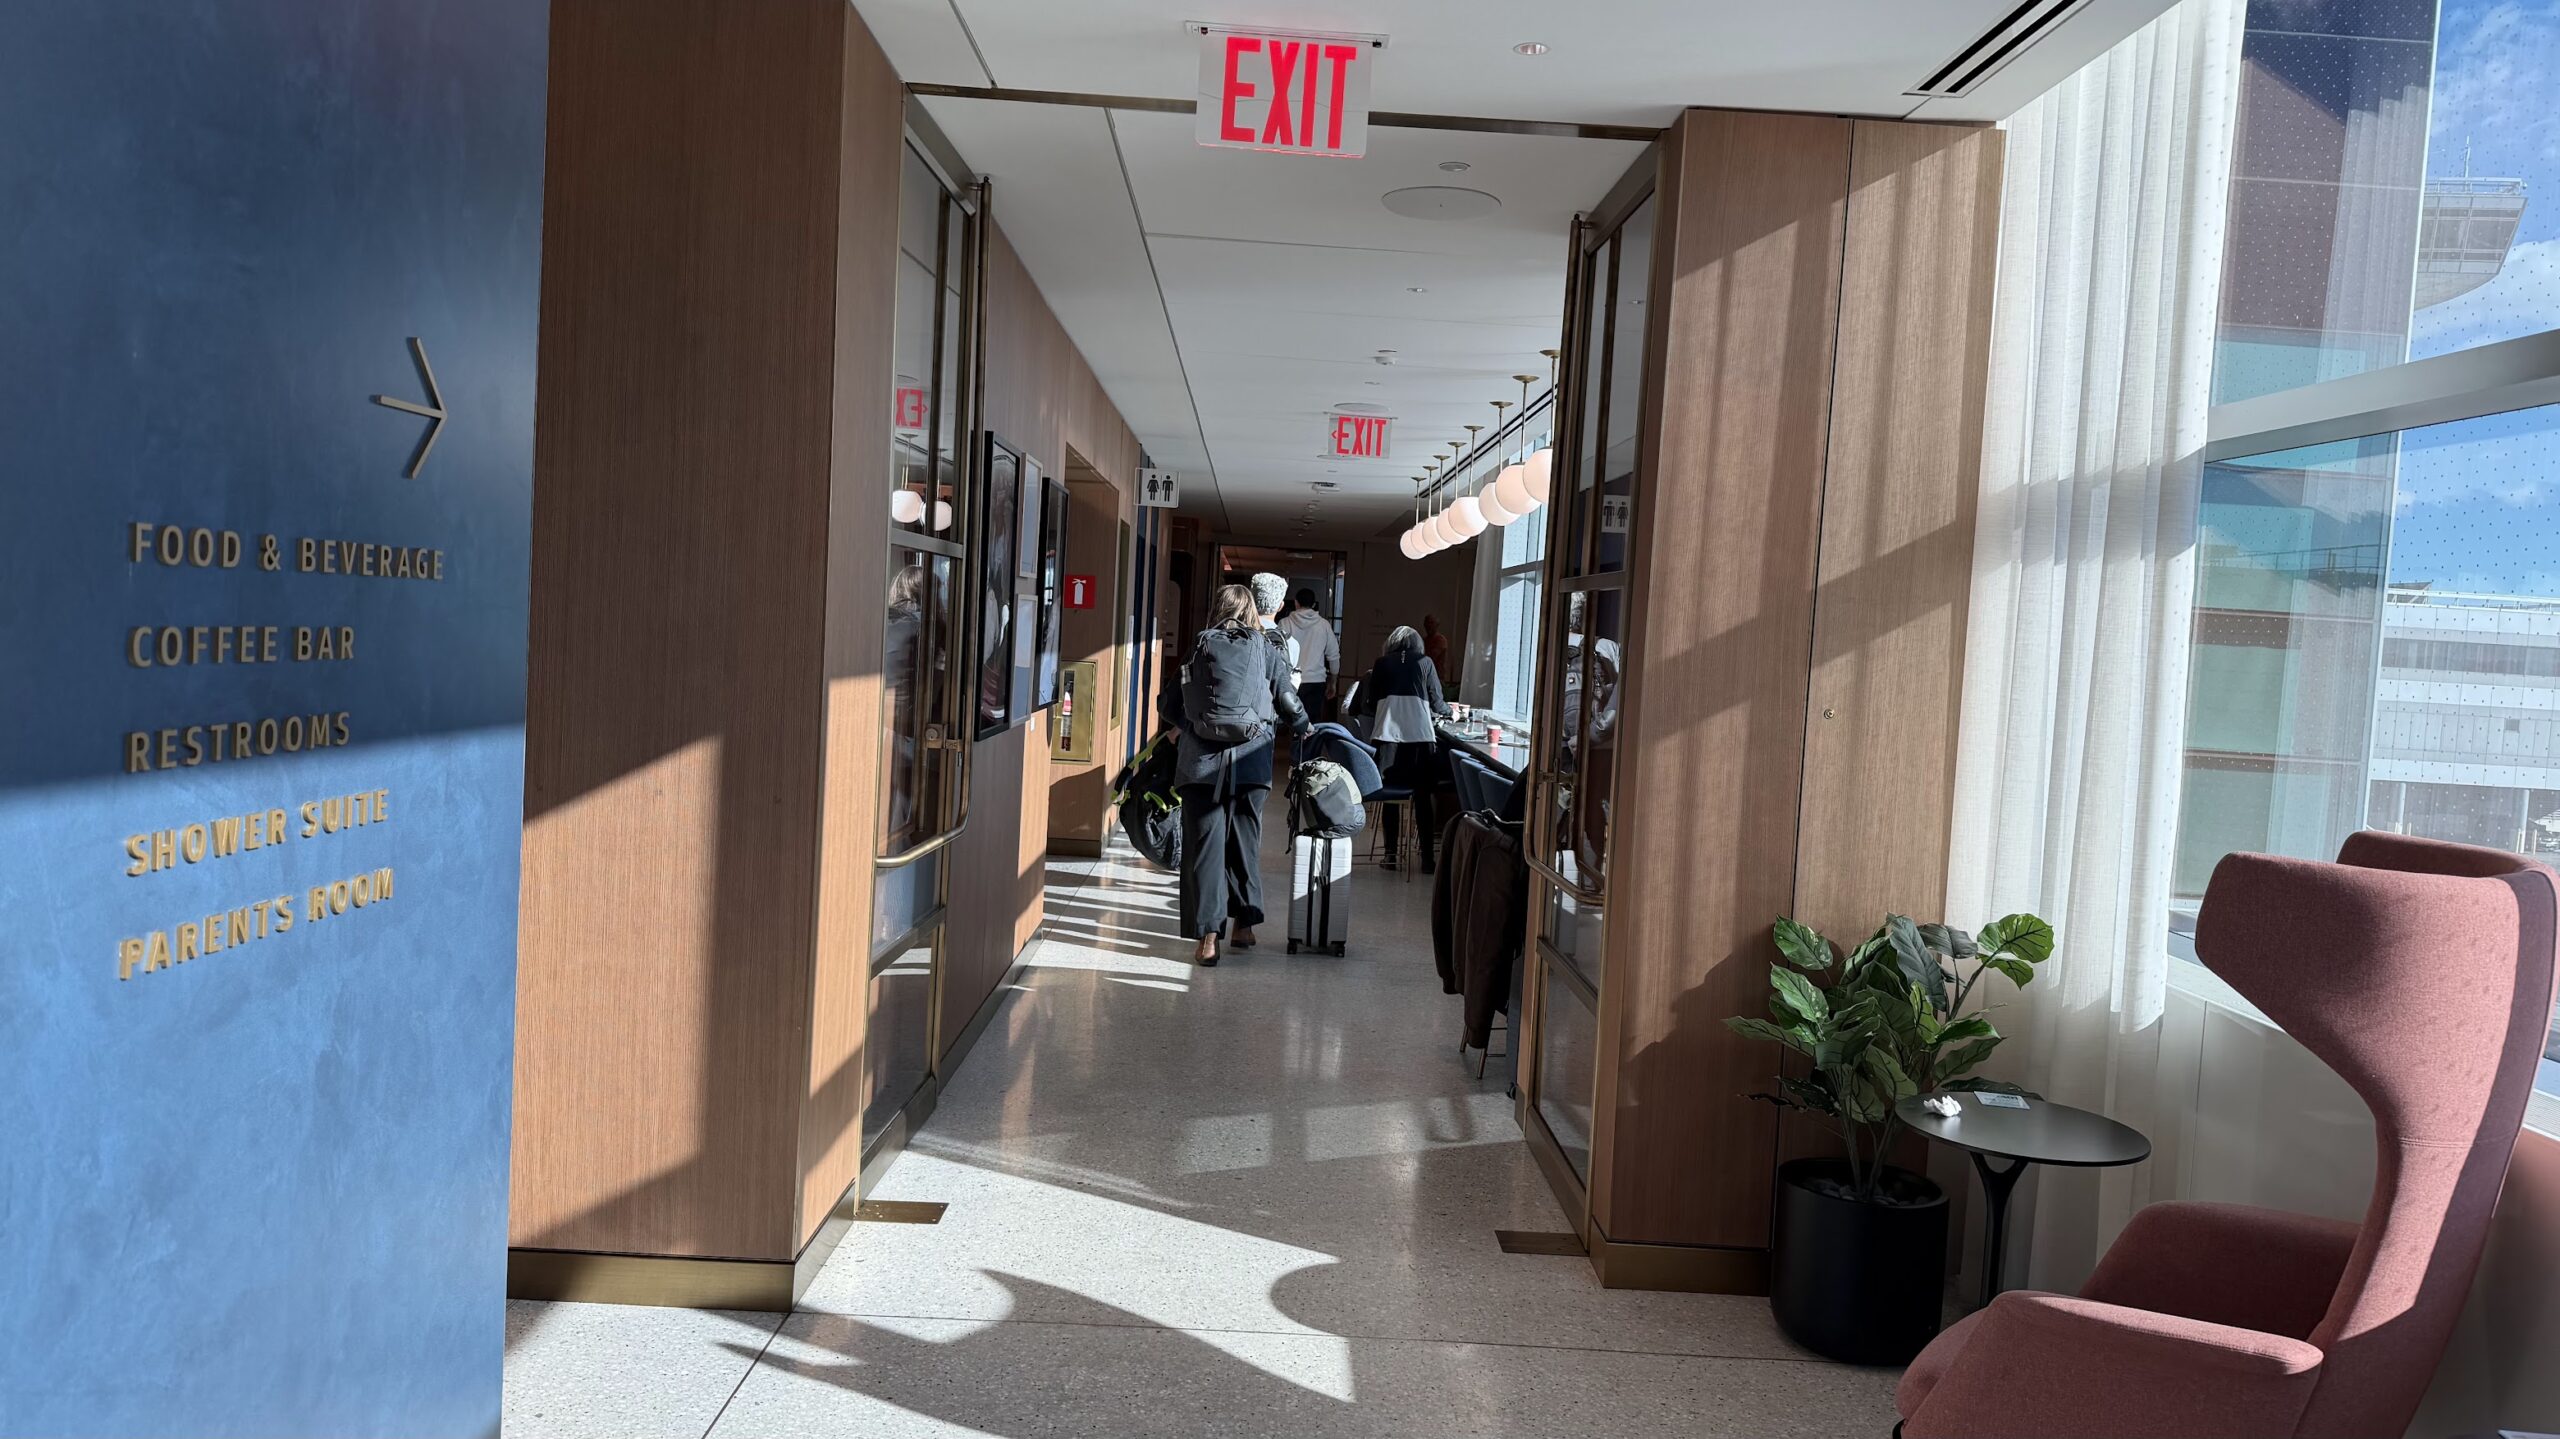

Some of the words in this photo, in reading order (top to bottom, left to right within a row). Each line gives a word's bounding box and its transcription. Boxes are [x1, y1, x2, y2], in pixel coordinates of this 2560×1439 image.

[1220, 36, 1357, 150] EXIT
[1336, 416, 1387, 457] EXIT
[130, 521, 241, 570] FOOD
[260, 534, 281, 571] &
[297, 537, 445, 580] BEVERAGE
[128, 626, 279, 667] COFFEE
[297, 626, 355, 661] BAR
[125, 711, 350, 773] RESTROOMS
[125, 808, 287, 877] SHOWER
[301, 789, 390, 838] SUITE
[119, 895, 294, 981] PARENTS
[307, 868, 395, 922] ROOM
